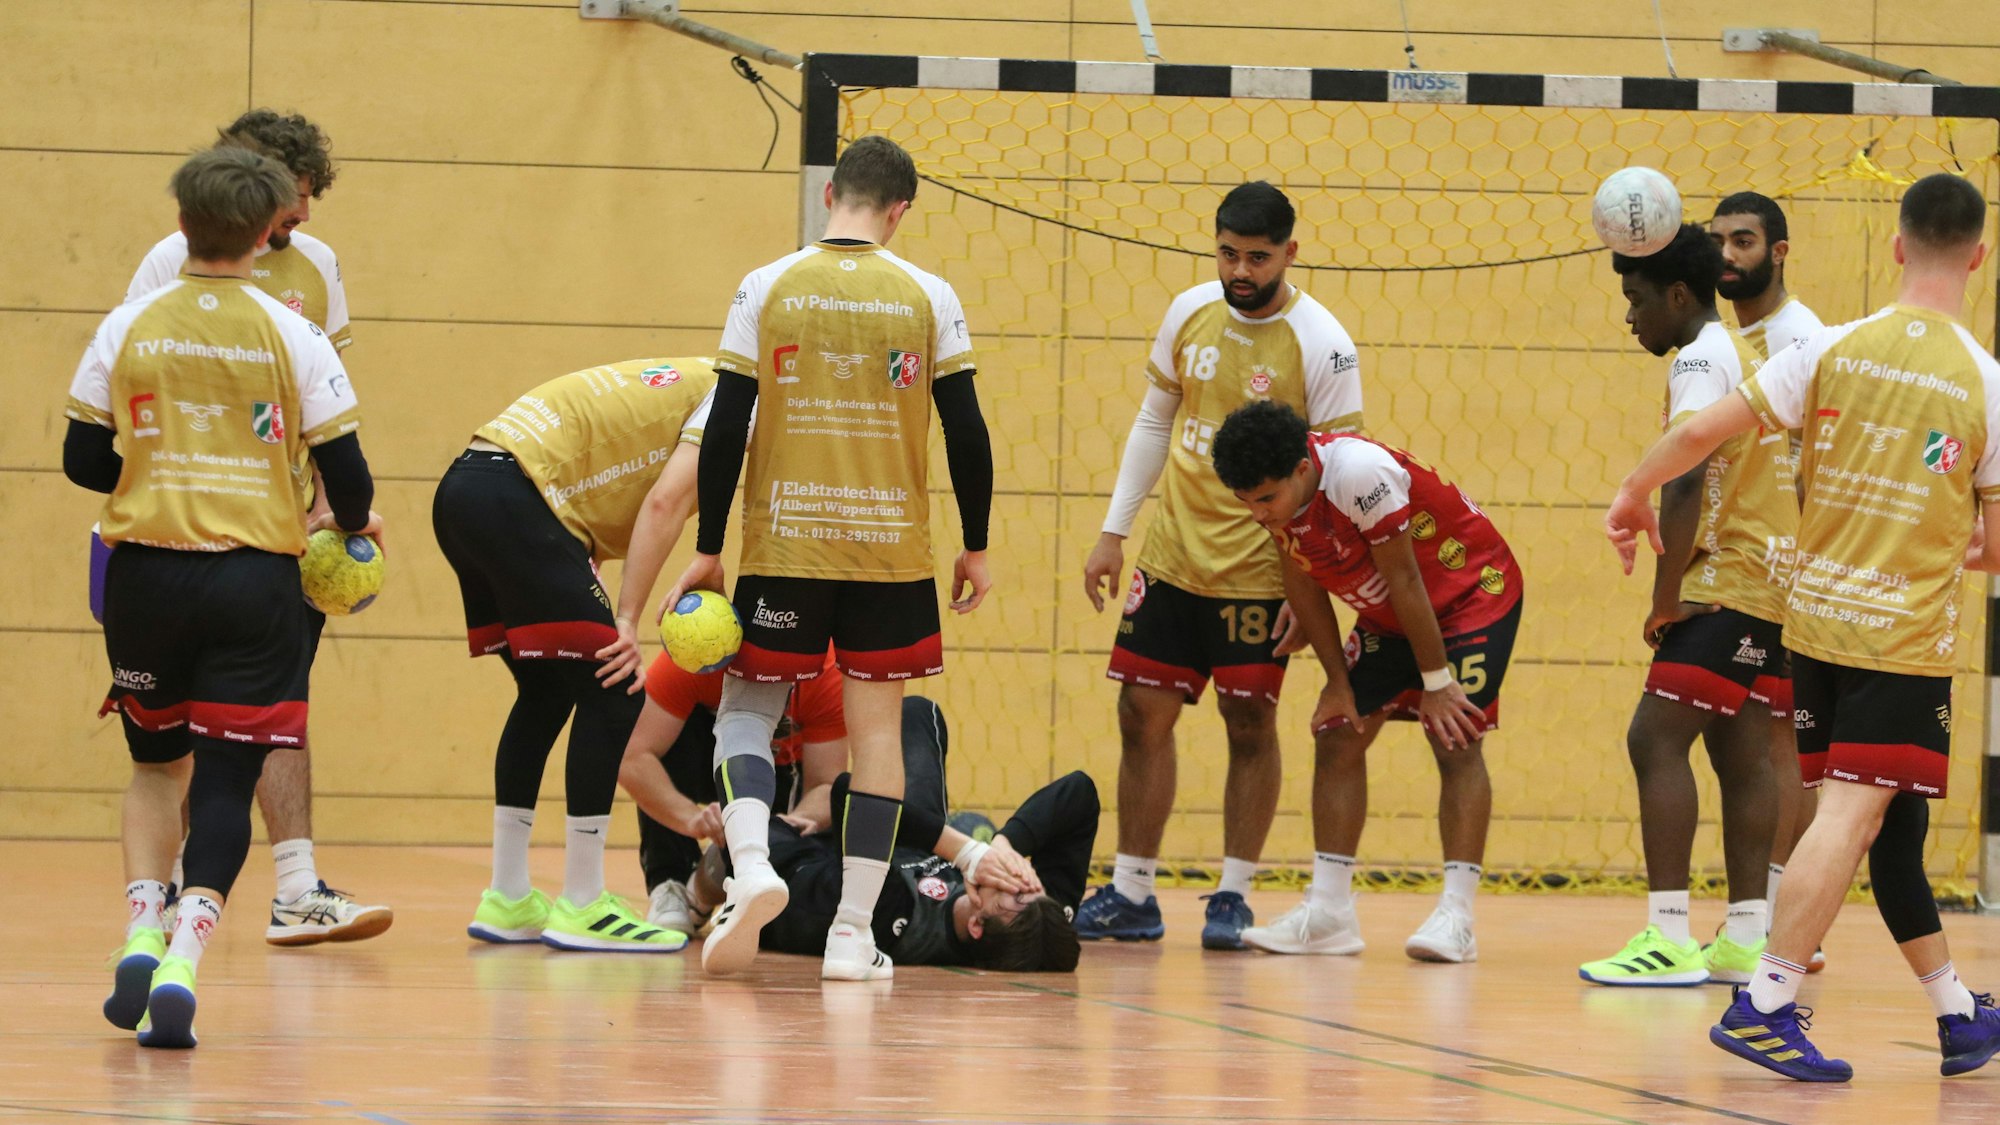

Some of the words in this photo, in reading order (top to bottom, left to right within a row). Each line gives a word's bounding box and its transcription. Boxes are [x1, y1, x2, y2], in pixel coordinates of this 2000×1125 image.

[1629, 193, 1646, 242] SELECT
[783, 296, 806, 311] TV
[808, 294, 913, 317] Palmersheim
[1224, 327, 1255, 347] Kempa
[135, 339, 159, 356] TV
[1183, 343, 1220, 381] 18
[1834, 357, 1859, 373] TV
[1859, 360, 1968, 402] Palmersheim
[787, 397, 833, 410] Dipl.-Ing.
[835, 399, 876, 410] Andreas
[786, 414, 817, 422] Beraten
[192, 452, 239, 466] Andreas
[242, 457, 270, 469] Kluß
[1862, 473, 1904, 490] Andreas
[782, 481, 908, 501] Elektrotechnik
[782, 500, 822, 512] Albert
[824, 501, 905, 517] Wipperfürth
[811, 527, 901, 543] 0173-2957637
[1802, 552, 1911, 591] Elektrotechnik
[1219, 605, 1269, 645] 18
[519, 649, 543, 658] Kempa
[557, 650, 583, 659] Kempa
[756, 673, 782, 682] Kempa
[796, 671, 818, 681] Kempa
[848, 668, 872, 679] Kempa
[887, 671, 912, 680] Kempa
[1656, 688, 1680, 701] Kempa
[1692, 699, 1712, 711] Kempa
[224, 730, 253, 742] Kempa
[271, 734, 298, 744] Kempa
[1833, 769, 1859, 781] Kempa
[1875, 777, 1898, 788] Kempa
[1913, 783, 1939, 794] Kempa
